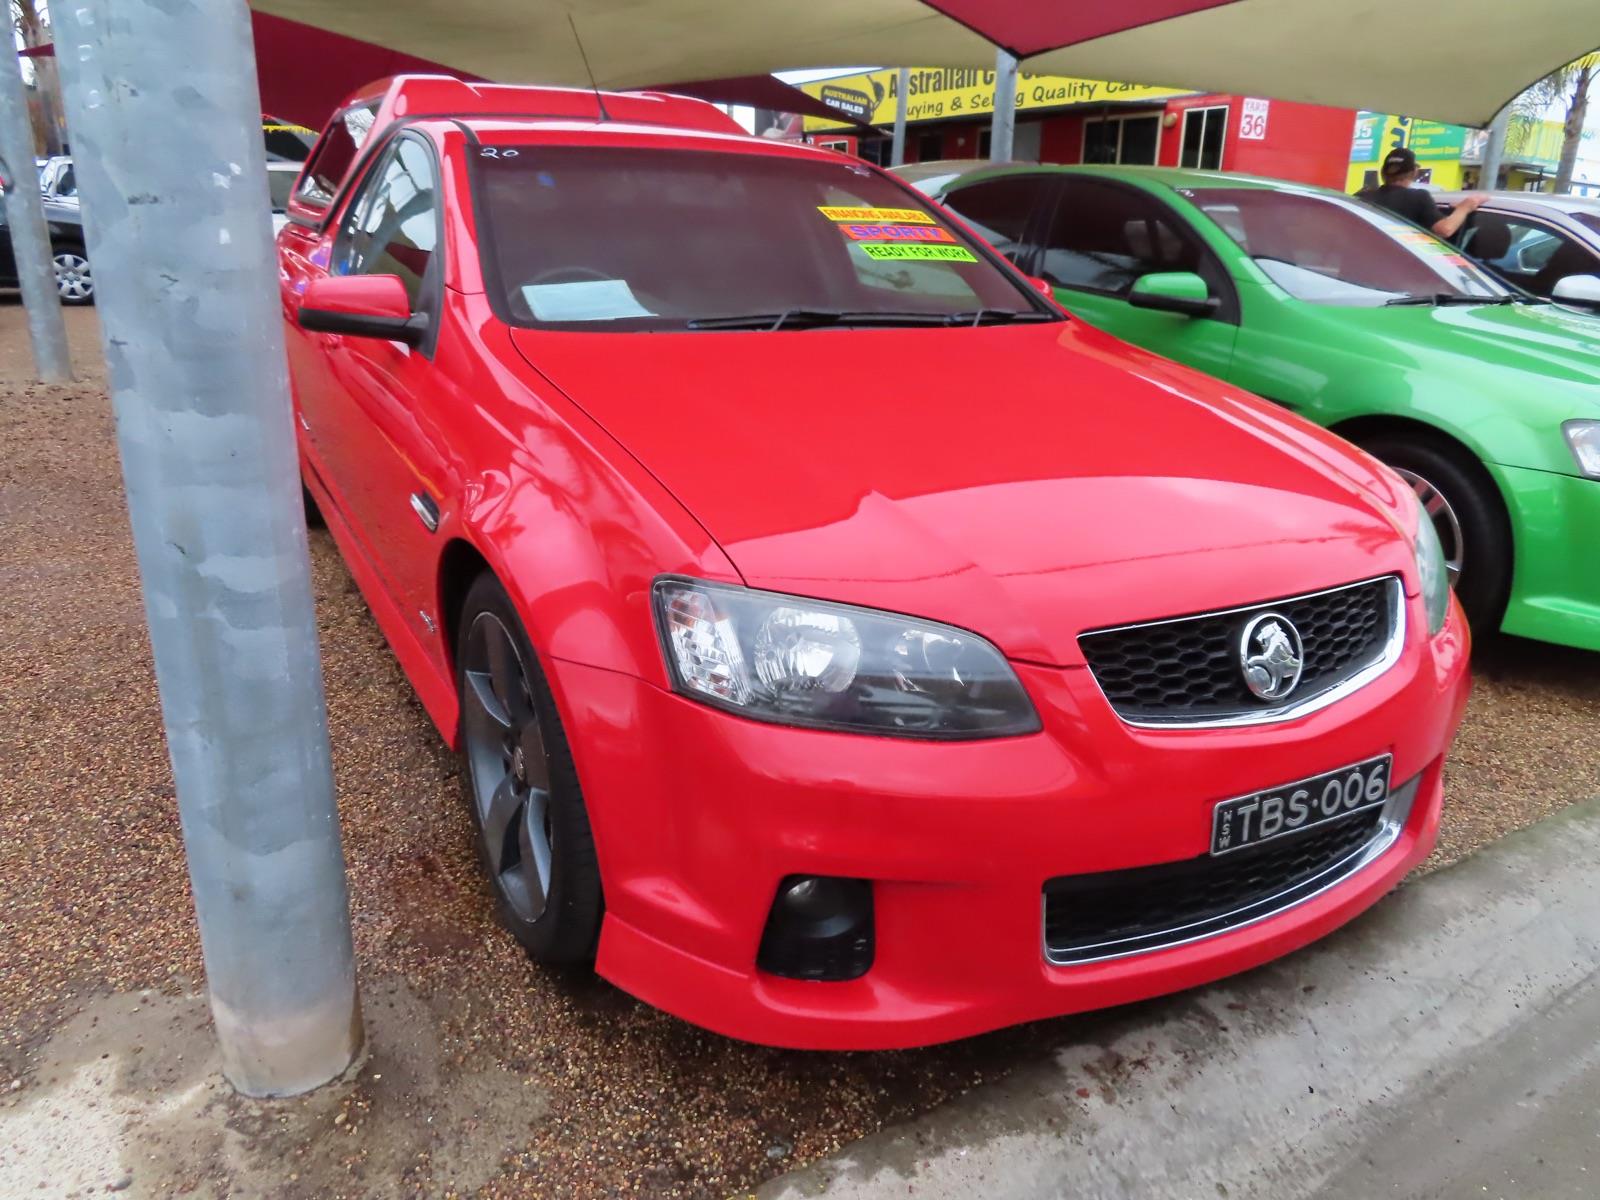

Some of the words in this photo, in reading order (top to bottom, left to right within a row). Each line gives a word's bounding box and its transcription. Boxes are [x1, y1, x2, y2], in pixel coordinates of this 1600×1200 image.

[889, 68, 977, 98] Astralian
[825, 98, 840, 109] CAR
[841, 102, 864, 114] SALES
[906, 101, 943, 118] uying
[951, 96, 962, 111] &
[1032, 82, 1097, 101] Quality
[1242, 114, 1265, 137] 36
[480, 147, 519, 159] 20
[850, 225, 941, 239] SPORTY
[865, 246, 908, 257] READY
[911, 247, 933, 257] FOR
[935, 248, 971, 259] WORK
